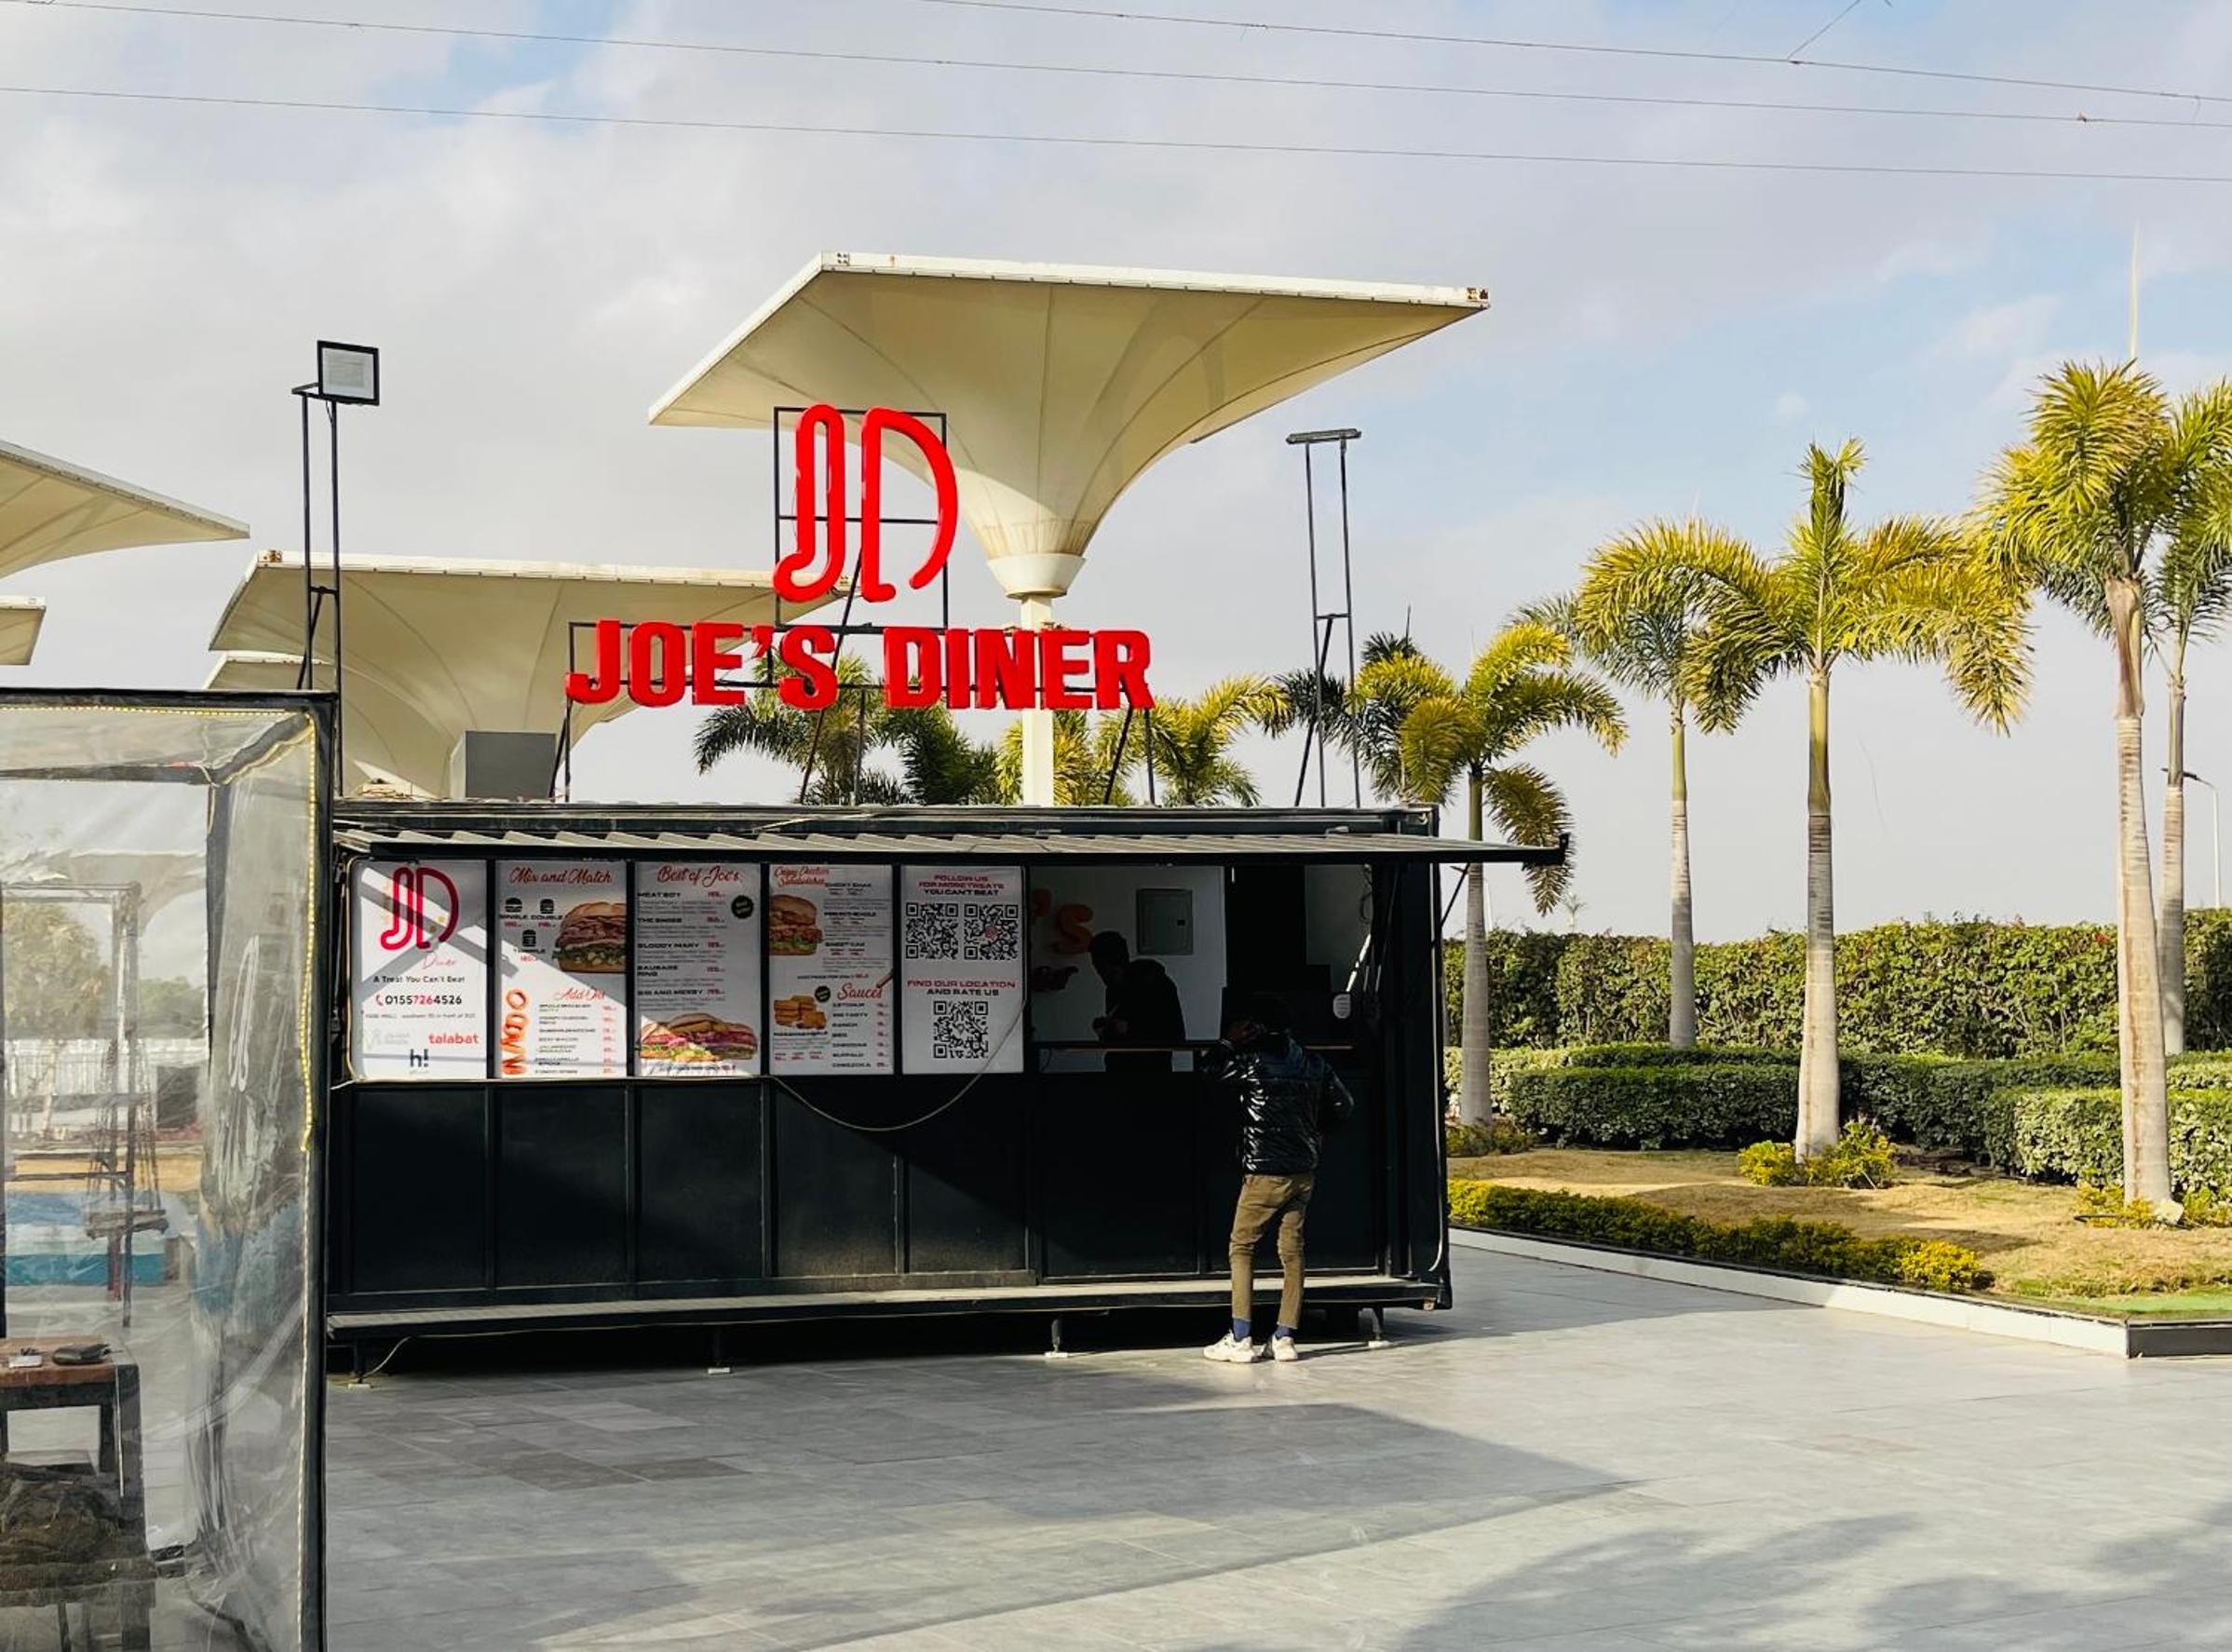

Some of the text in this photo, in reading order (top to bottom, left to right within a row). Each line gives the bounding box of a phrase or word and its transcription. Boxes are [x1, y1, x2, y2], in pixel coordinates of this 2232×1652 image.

[566, 618, 1156, 711] JOE'S DINER
[509, 867, 612, 885] Mix and Match
[657, 865, 688, 883] Best
[689, 868, 702, 887] of
[428, 1033, 479, 1045] talabat
